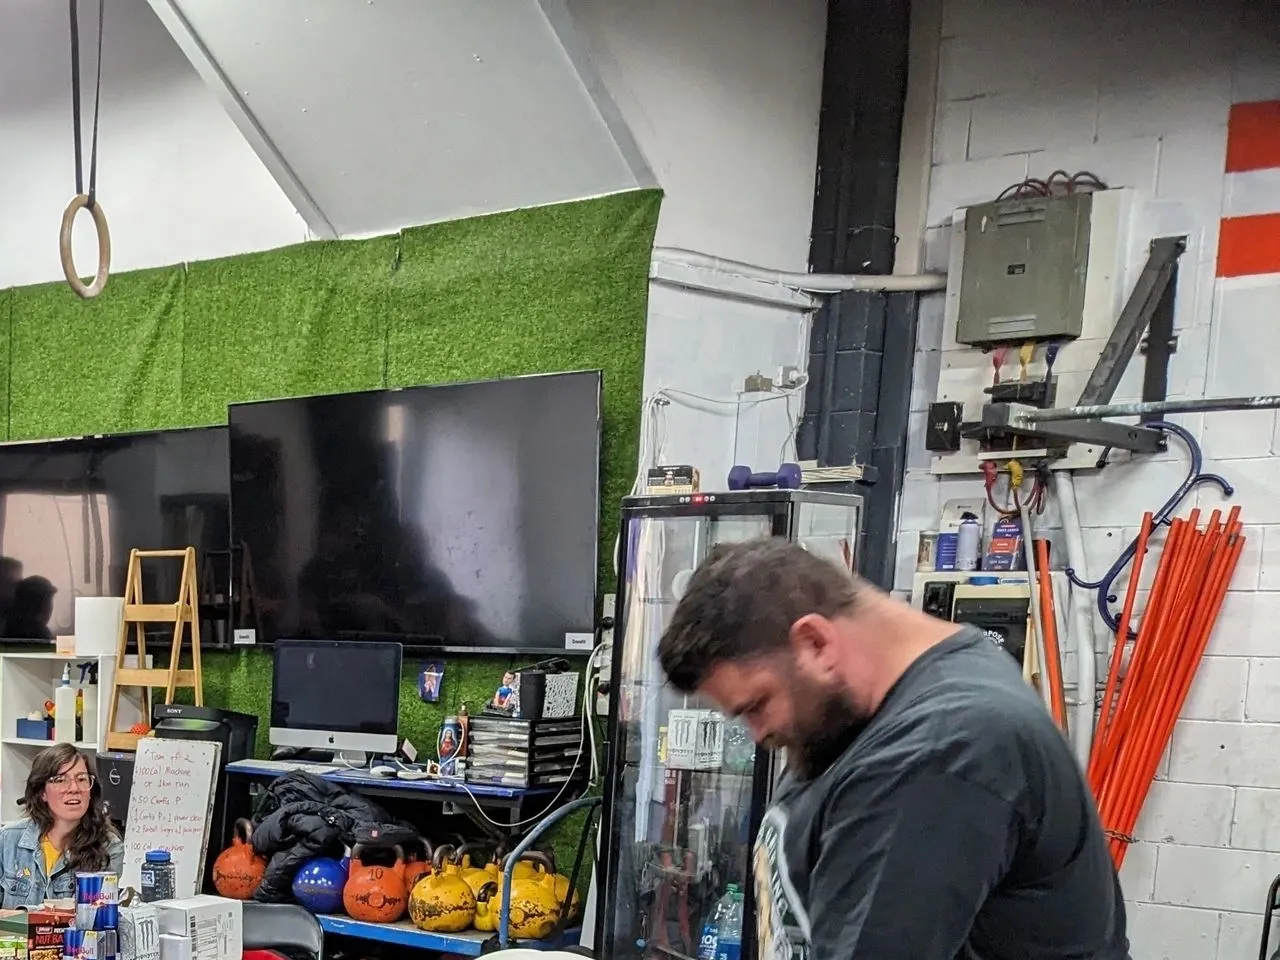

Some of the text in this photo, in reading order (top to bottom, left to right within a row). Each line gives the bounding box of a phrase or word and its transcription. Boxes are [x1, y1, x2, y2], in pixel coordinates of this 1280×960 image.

[368, 868, 384, 881] 10
[36, 934, 64, 944] NUT BA
